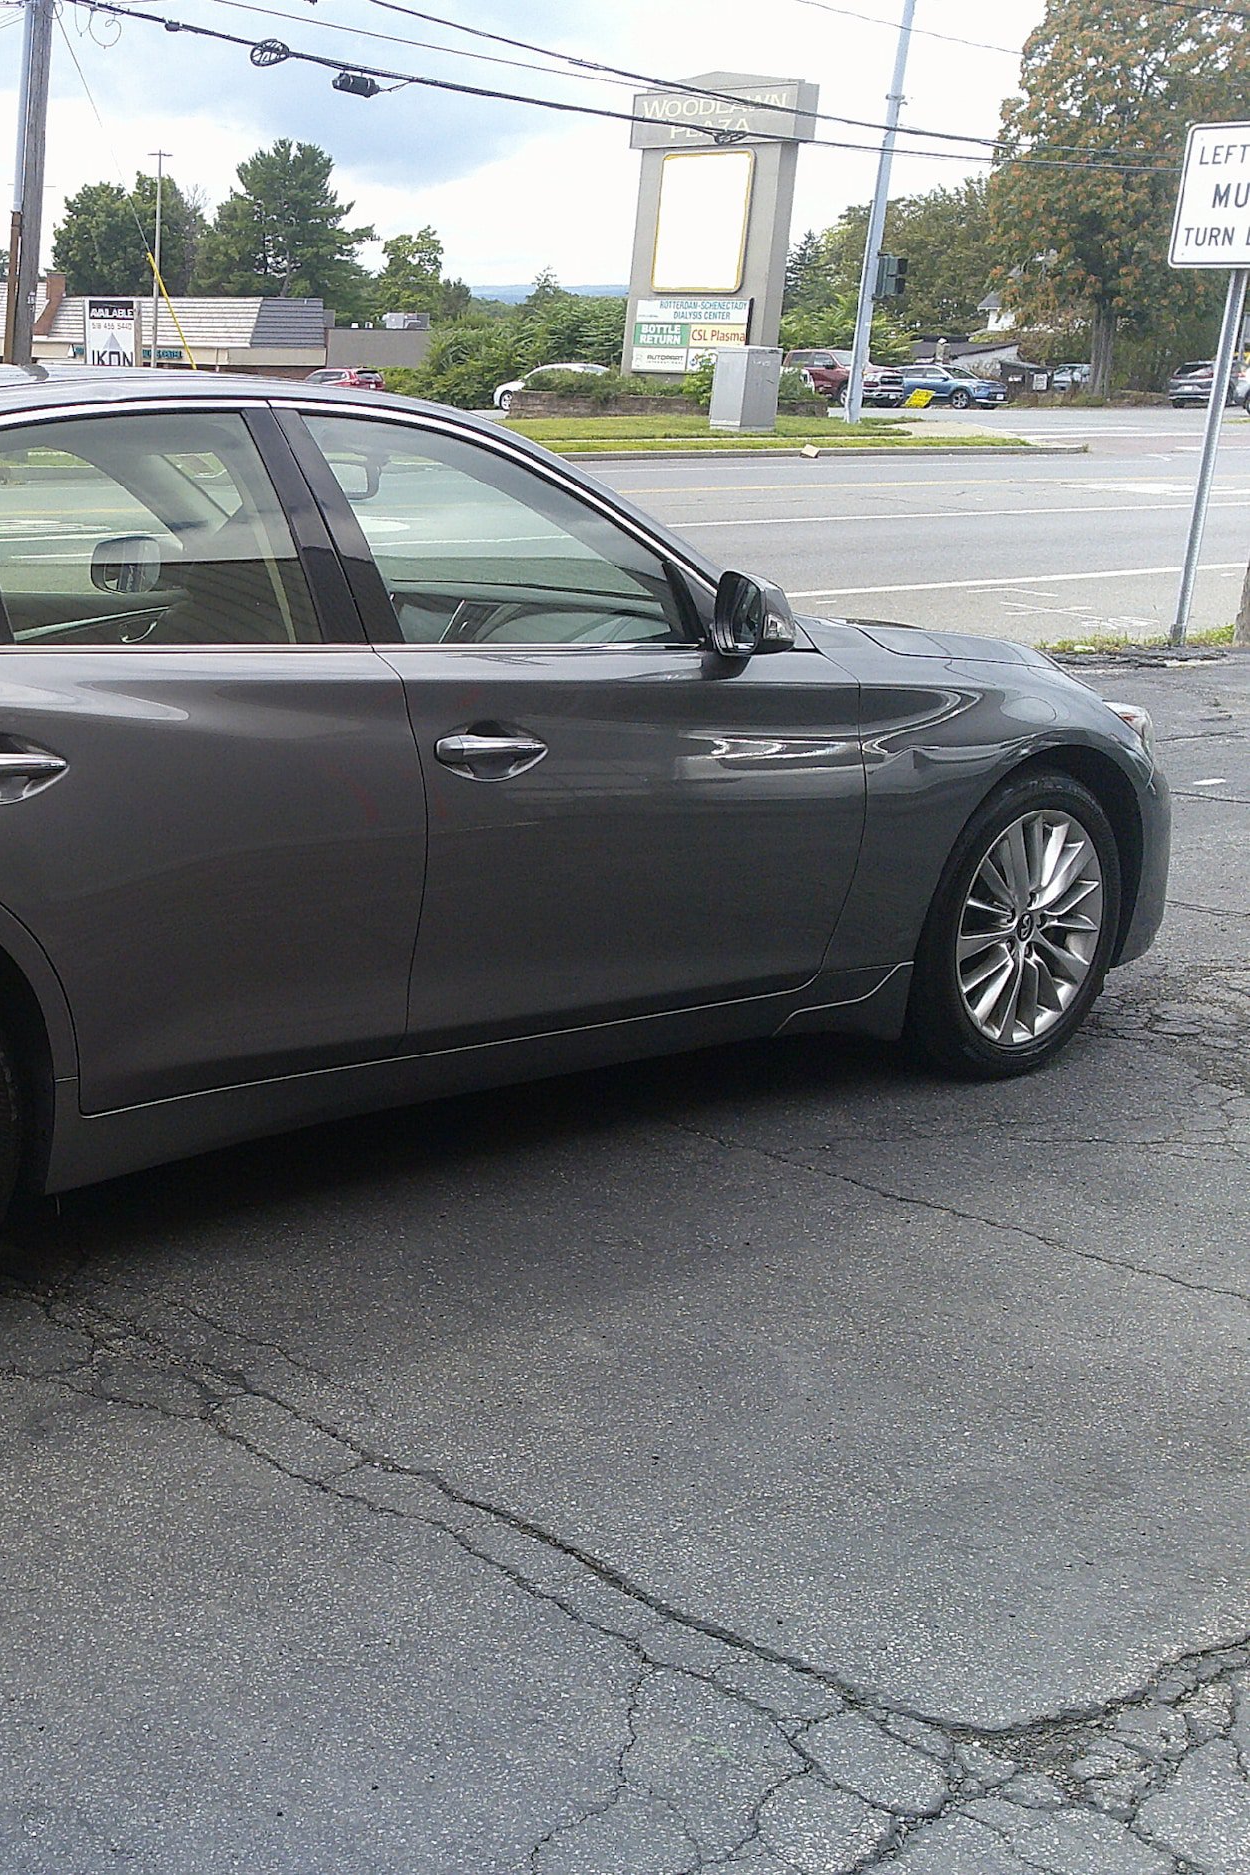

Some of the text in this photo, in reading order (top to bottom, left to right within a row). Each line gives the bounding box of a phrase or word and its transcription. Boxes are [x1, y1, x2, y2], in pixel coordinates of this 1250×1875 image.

[1199, 145, 1250, 165] LEFT
[1184, 227, 1235, 246] TURN
[659, 300, 747, 310] ROTTERDAM-SCHENECTADY
[90, 308, 134, 318] AVAILABLE
[673, 311, 731, 320] DIALYSIS CENTER
[641, 325, 681, 334] BOTTLE
[639, 335, 681, 344] RETURN
[691, 328, 746, 342] CSL Plasma
[92, 350, 134, 366] IKON
